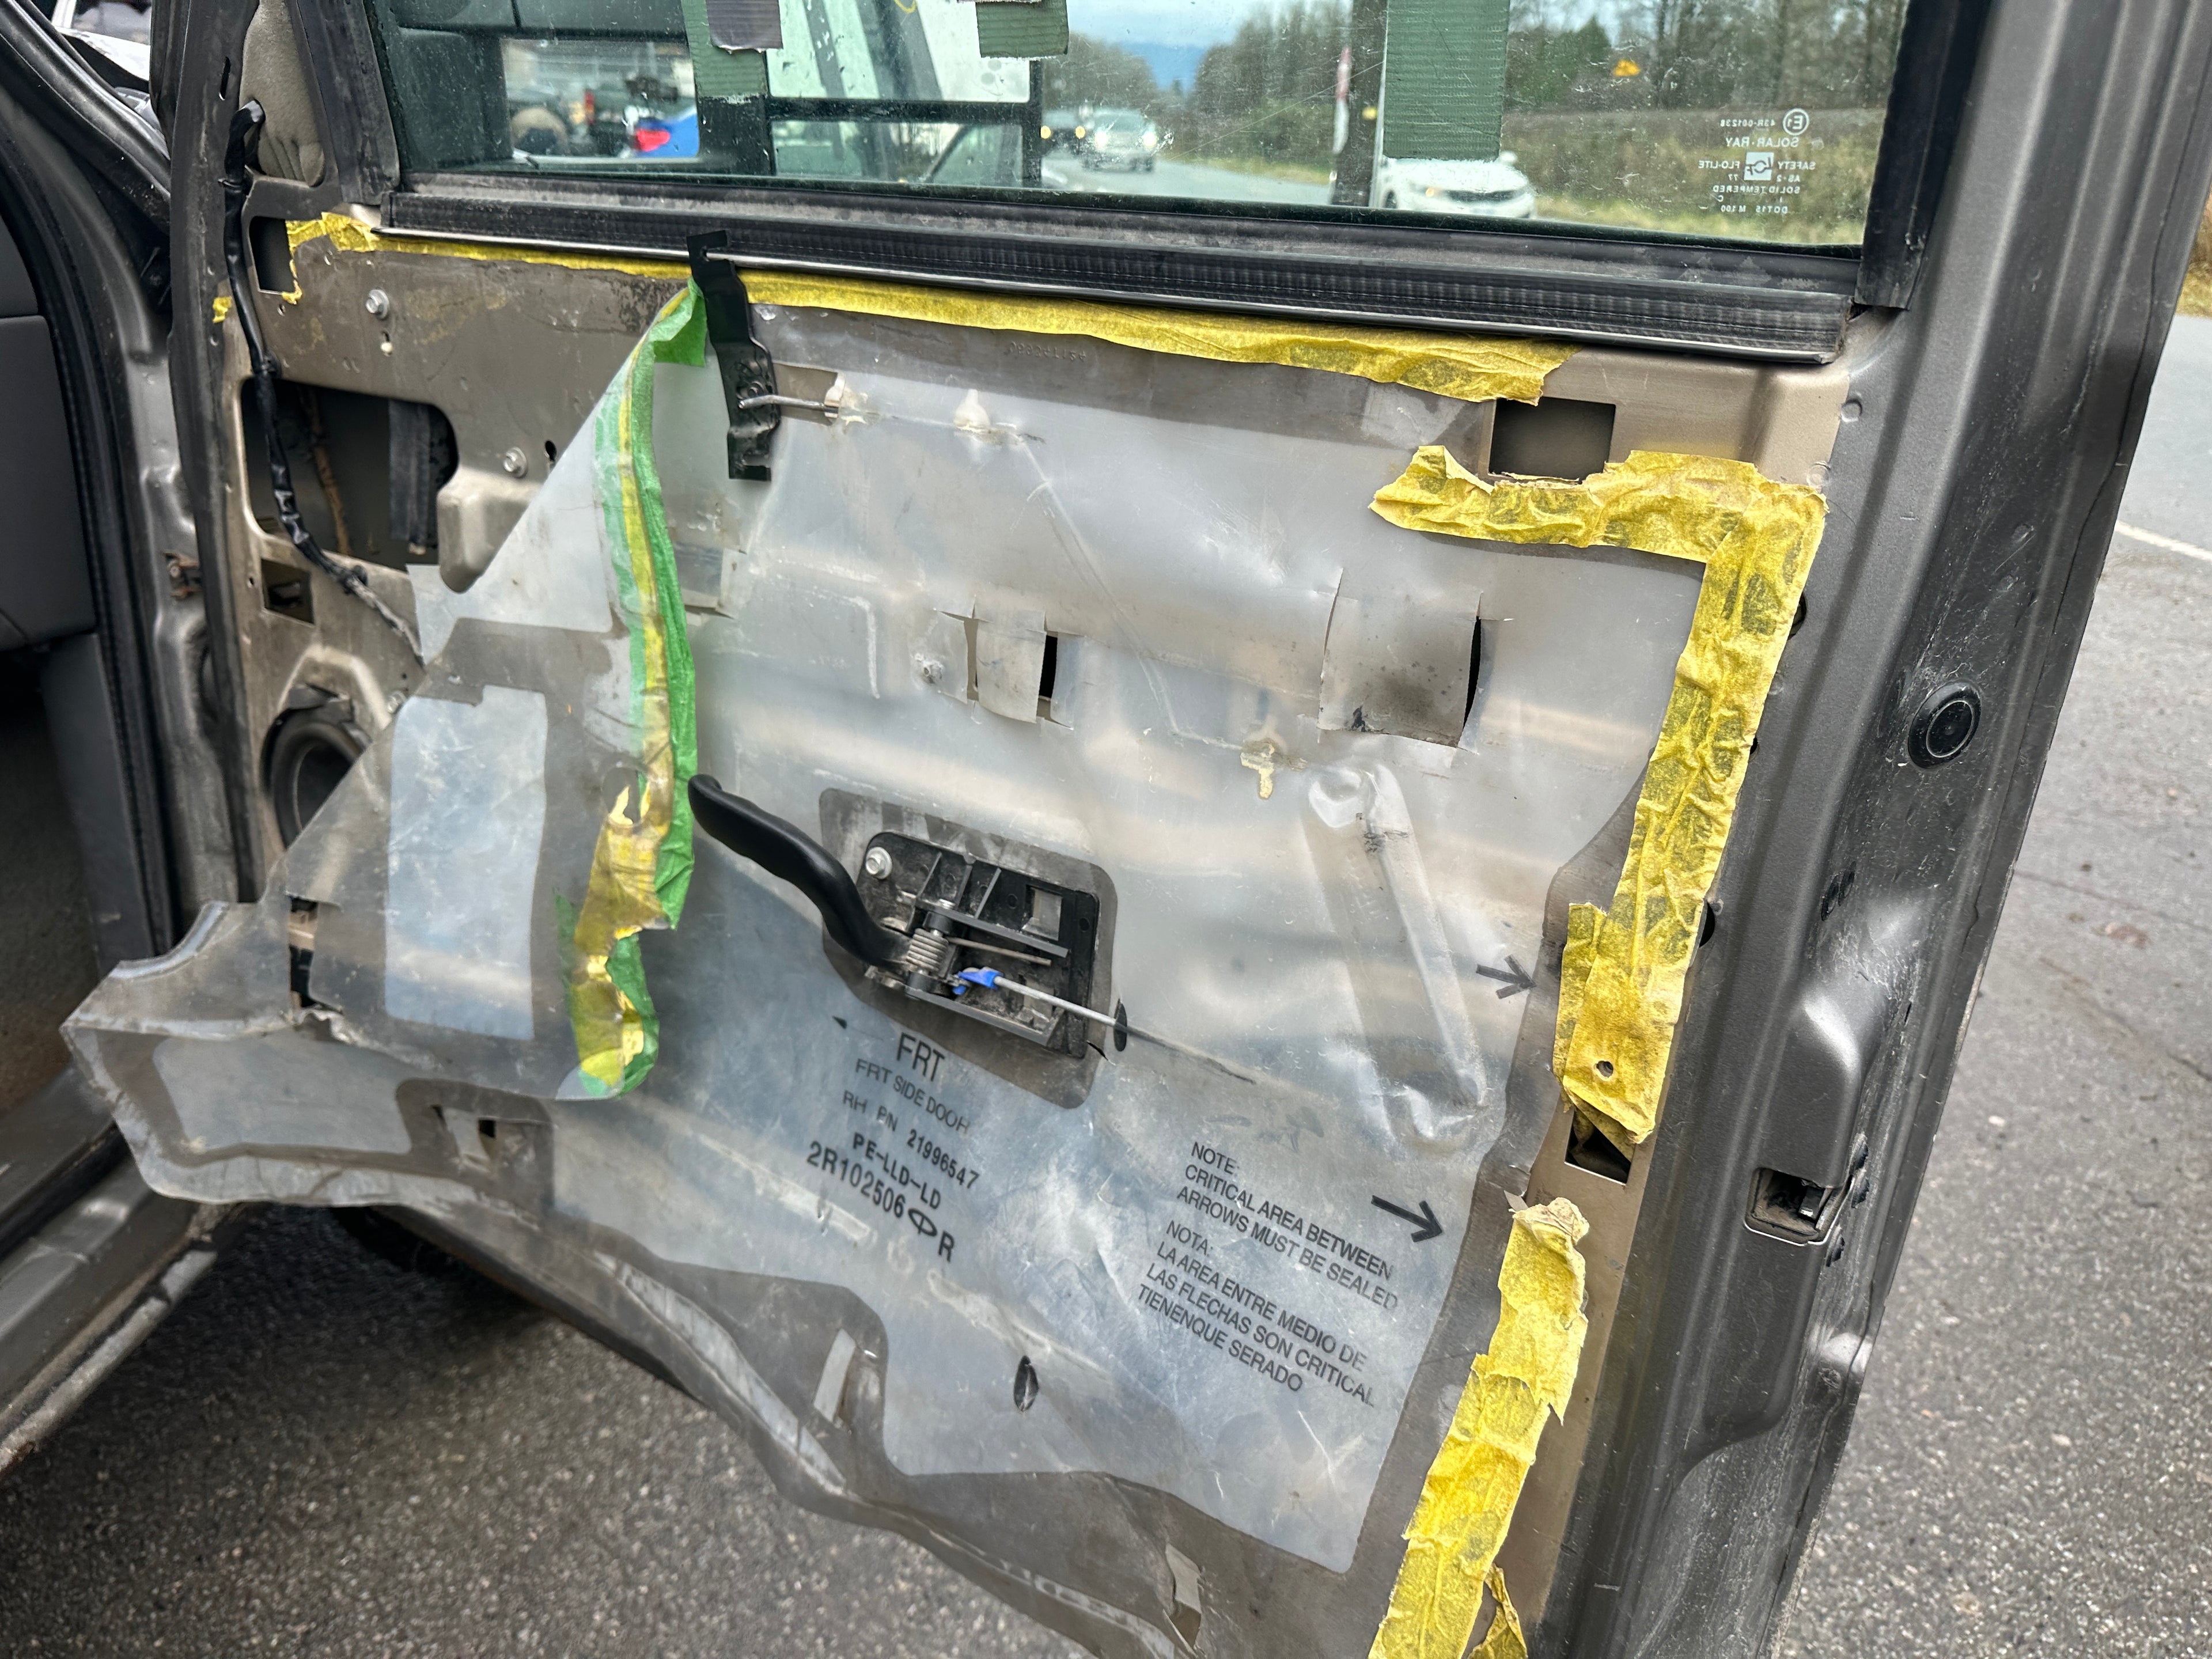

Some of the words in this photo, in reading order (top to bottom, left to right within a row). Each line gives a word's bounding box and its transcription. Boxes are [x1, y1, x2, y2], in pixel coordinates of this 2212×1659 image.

[855, 1059, 892, 1084] FRT
[893, 1075, 924, 1106] SIDE
[896, 1032, 945, 1081] FRT
[843, 1090, 867, 1114] RH
[907, 1128, 980, 1190] 21996547
[938, 1232, 955, 1262] R
[1166, 1219, 1213, 1256] NOTA:
[1177, 1186, 1249, 1233] ARROWS
[1250, 1224, 1298, 1259] MUST
[1300, 1247, 1330, 1274] BE
[1326, 1266, 1398, 1310] SEALED
[1184, 1164, 1256, 1213] CRITICAL
[1254, 1200, 1304, 1235] AREA
[1306, 1224, 1394, 1281] BETWEEN
[1137, 1283, 1226, 1349] TIENENQUE
[1229, 1339, 1304, 1393] SERADO
[1146, 1263, 1176, 1290] LAS
[1179, 1282, 1251, 1333] FLECHAS
[1253, 1320, 1293, 1359] SON
[1295, 1348, 1376, 1408] CRITICAL
[1157, 1241, 1179, 1266] LA
[1176, 1252, 1220, 1285] AREA
[1222, 1276, 1275, 1321] ENTRE
[1278, 1310, 1337, 1354] MEDIO
[1339, 1341, 1368, 1372] DE
